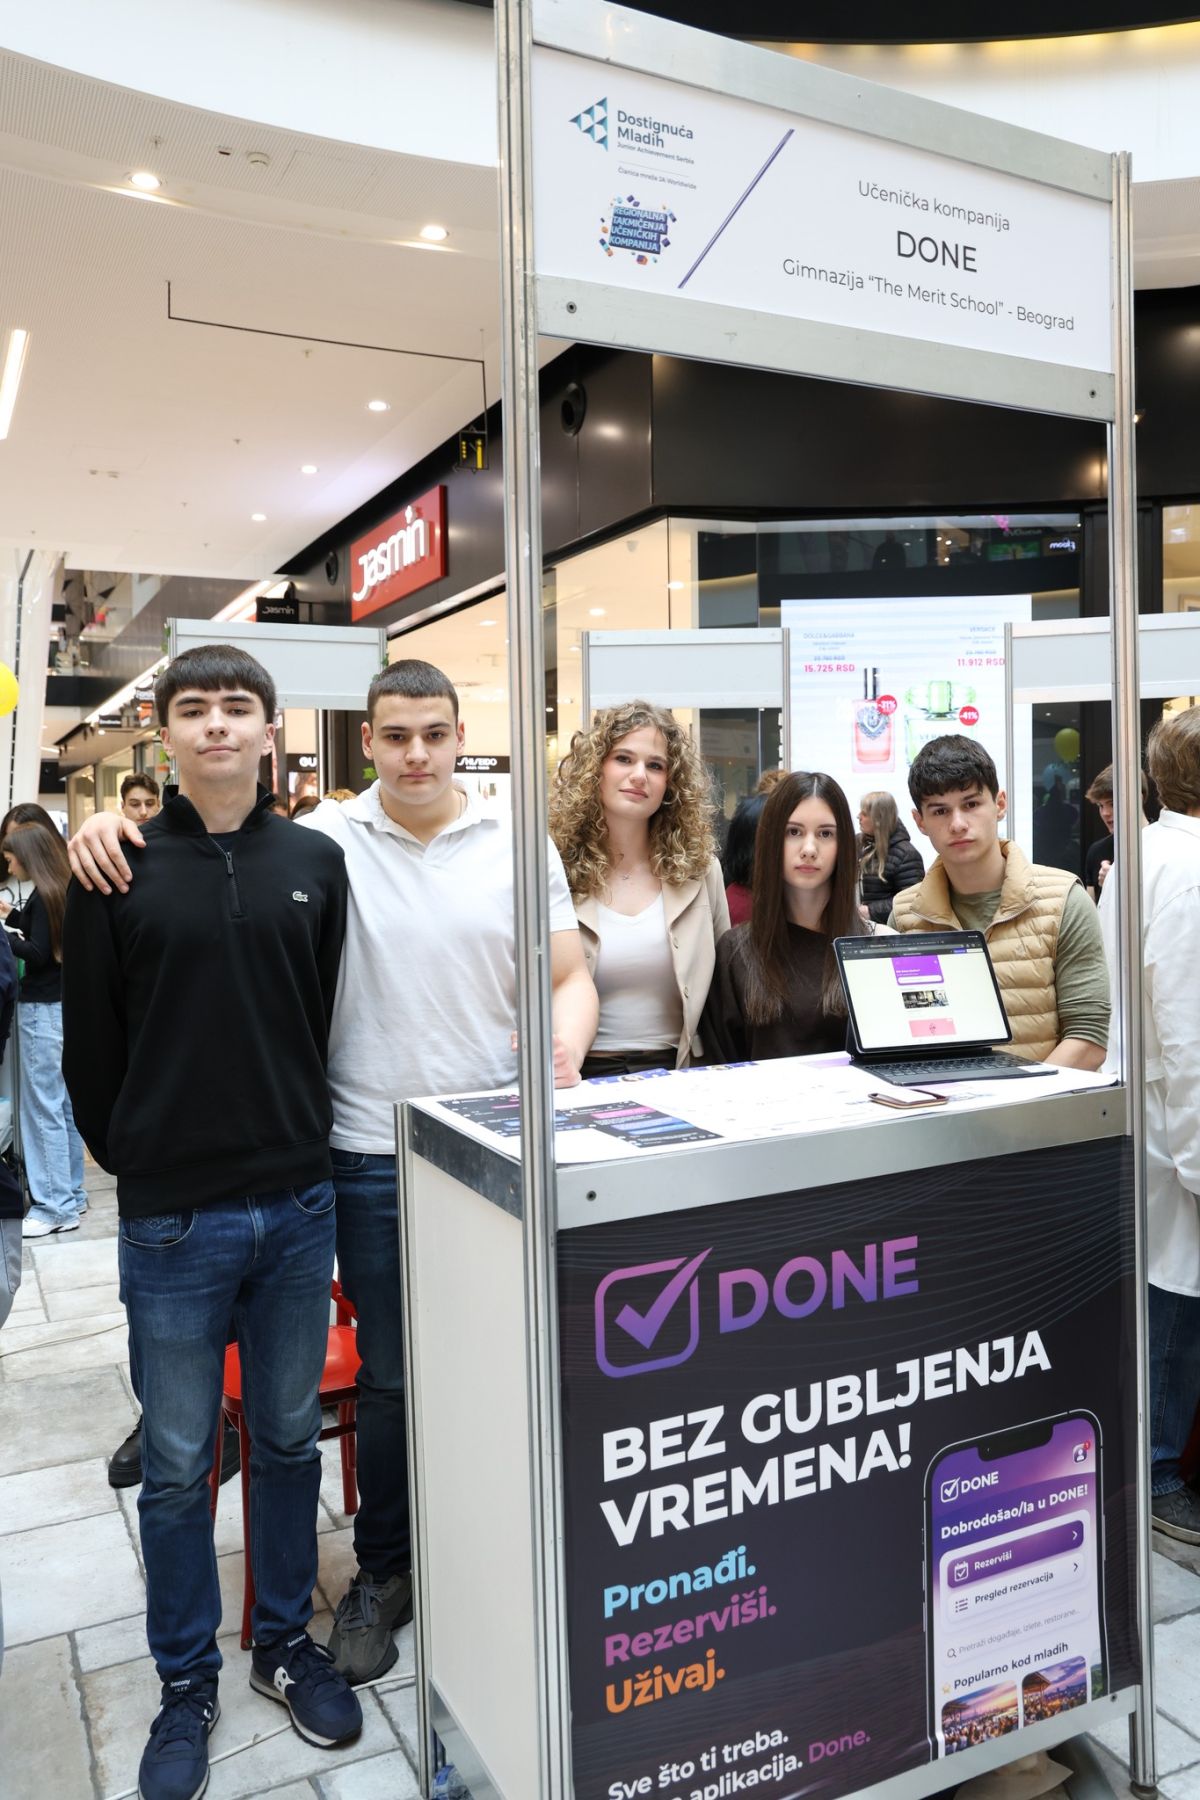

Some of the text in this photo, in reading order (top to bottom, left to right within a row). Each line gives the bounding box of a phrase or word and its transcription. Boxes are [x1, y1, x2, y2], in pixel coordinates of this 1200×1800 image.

[617, 110, 693, 139] Dostignuća
[617, 126, 664, 148] Mladih
[637, 147, 675, 160] Achievement
[613, 216, 665, 231] TAKMIČENJA
[614, 207, 665, 221] REGIONALNA
[858, 180, 1010, 232] Učenička kompanija
[609, 236, 658, 251] KOMPANIJA
[611, 225, 658, 241] UČENIČKIH
[897, 230, 978, 273] DONE
[782, 258, 864, 291] Gimnazija
[908, 284, 946, 306] Merit
[1017, 306, 1075, 331] Beograd
[352, 505, 428, 602] Jasmin
[804, 664, 855, 672] 15.725 RSD
[957, 658, 1006, 666] 11.912 RSD
[718, 1235, 919, 1334] DONE
[602, 1330, 1052, 1482] BEZ GUBLJENJA
[599, 1422, 912, 1547] VREMENA!
[961, 1471, 999, 1494] DONE
[940, 1483, 1088, 1539] Dobrodošao/la u DONE!
[974, 1550, 1012, 1571] Rezerviši
[603, 1544, 756, 1619] Pronađi.
[974, 1572, 1054, 1605] Pregled rezervacija
[605, 1585, 777, 1667] Rezerviši.
[958, 1638, 986, 1654] Pretraži
[605, 1648, 726, 1714] Uživaj.
[954, 1642, 1069, 1690] Popularno kod mladih
[808, 1729, 871, 1764] Done.
[608, 1729, 789, 1800] Sve što ti treba.
